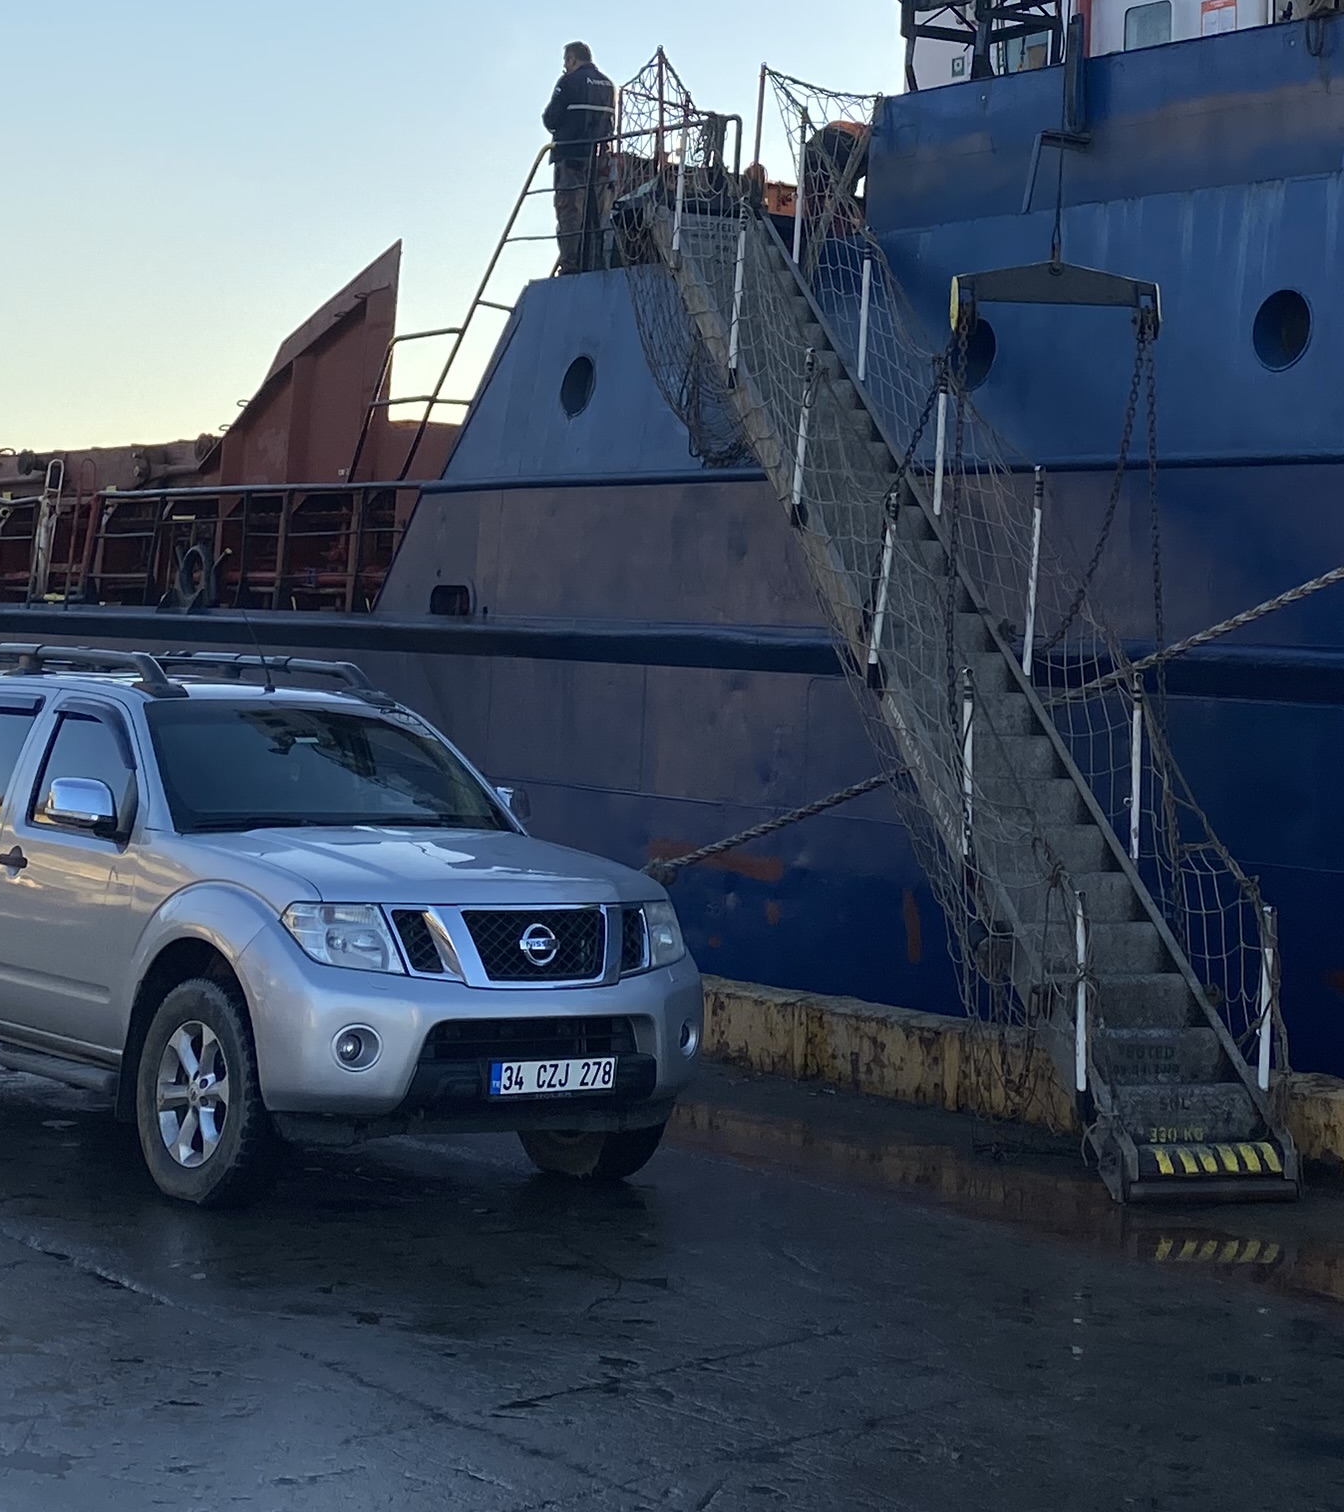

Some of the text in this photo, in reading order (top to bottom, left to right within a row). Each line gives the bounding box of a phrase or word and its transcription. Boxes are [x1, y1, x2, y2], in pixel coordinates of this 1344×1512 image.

[502, 1060, 613, 1091] 34 CZJ 278
